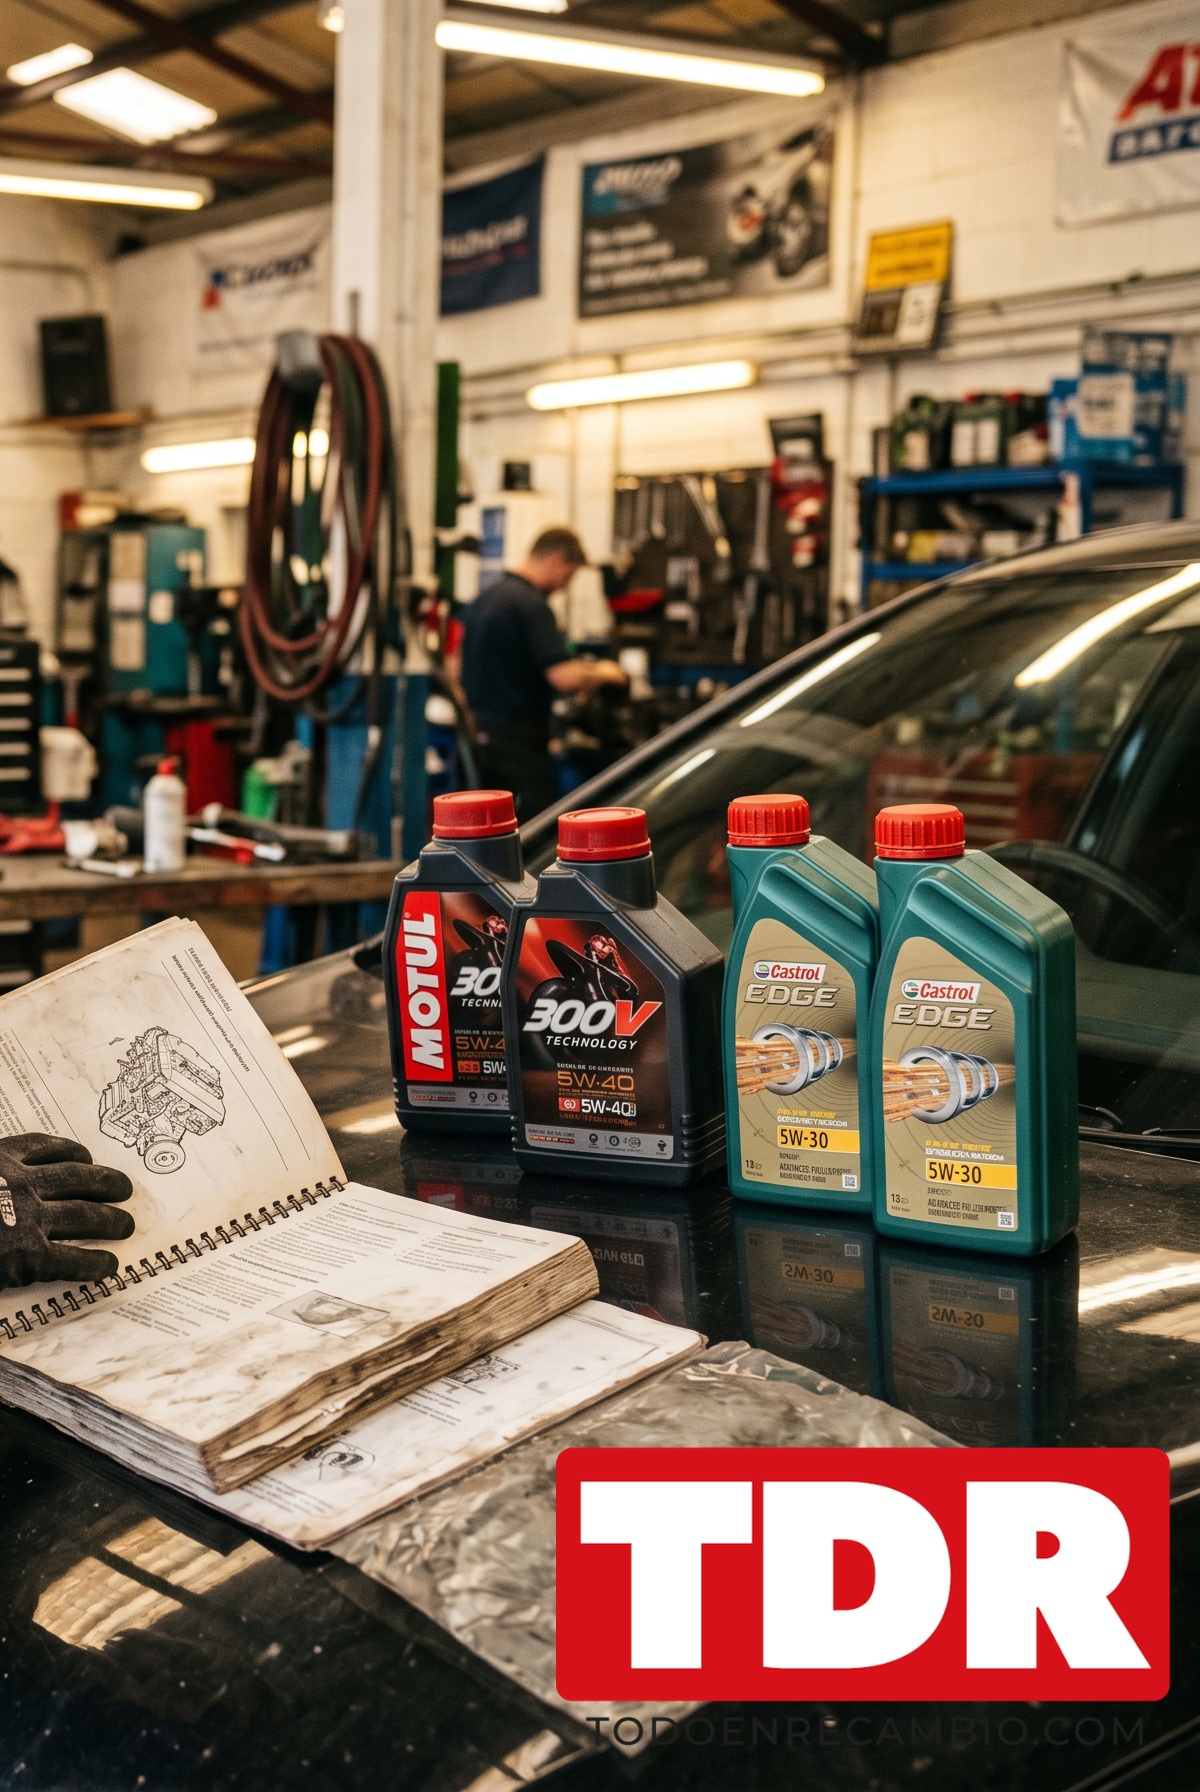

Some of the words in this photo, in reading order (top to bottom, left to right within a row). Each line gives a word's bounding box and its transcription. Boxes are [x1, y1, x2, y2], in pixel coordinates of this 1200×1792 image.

[450, 966, 502, 997] 30
[770, 963, 820, 981] Castrol
[403, 913, 445, 1070] MOTUL
[744, 983, 840, 1008] EDGE
[919, 982, 974, 1001] Castrol
[522, 998, 663, 1037] 300V
[891, 1002, 997, 1030] EDGE
[545, 1035, 638, 1050] TECHNOLOGY
[780, 1128, 828, 1149] 5W-30
[928, 1161, 982, 1184] 5W-30
